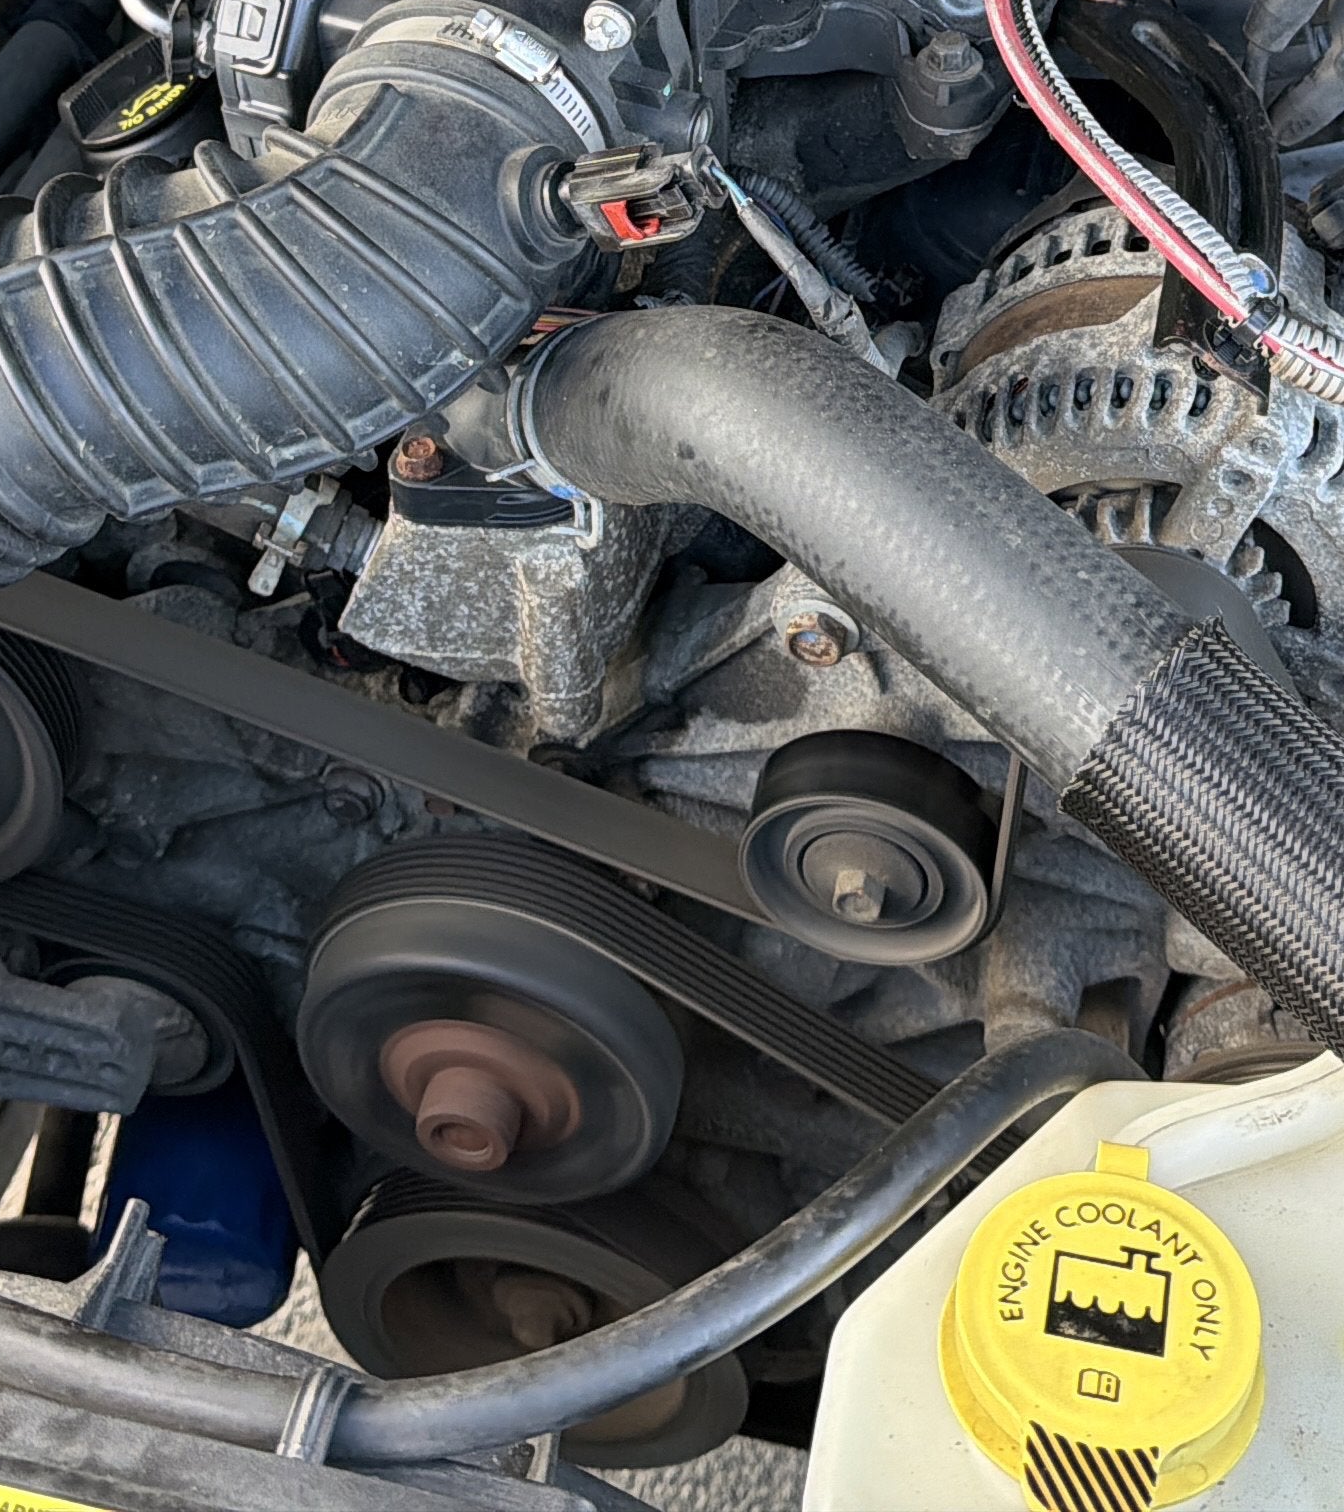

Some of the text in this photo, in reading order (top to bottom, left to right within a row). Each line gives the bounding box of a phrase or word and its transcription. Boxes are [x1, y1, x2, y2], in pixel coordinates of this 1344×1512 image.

[999, 1201, 1223, 1363] ENGINE COOLANT ONLY
